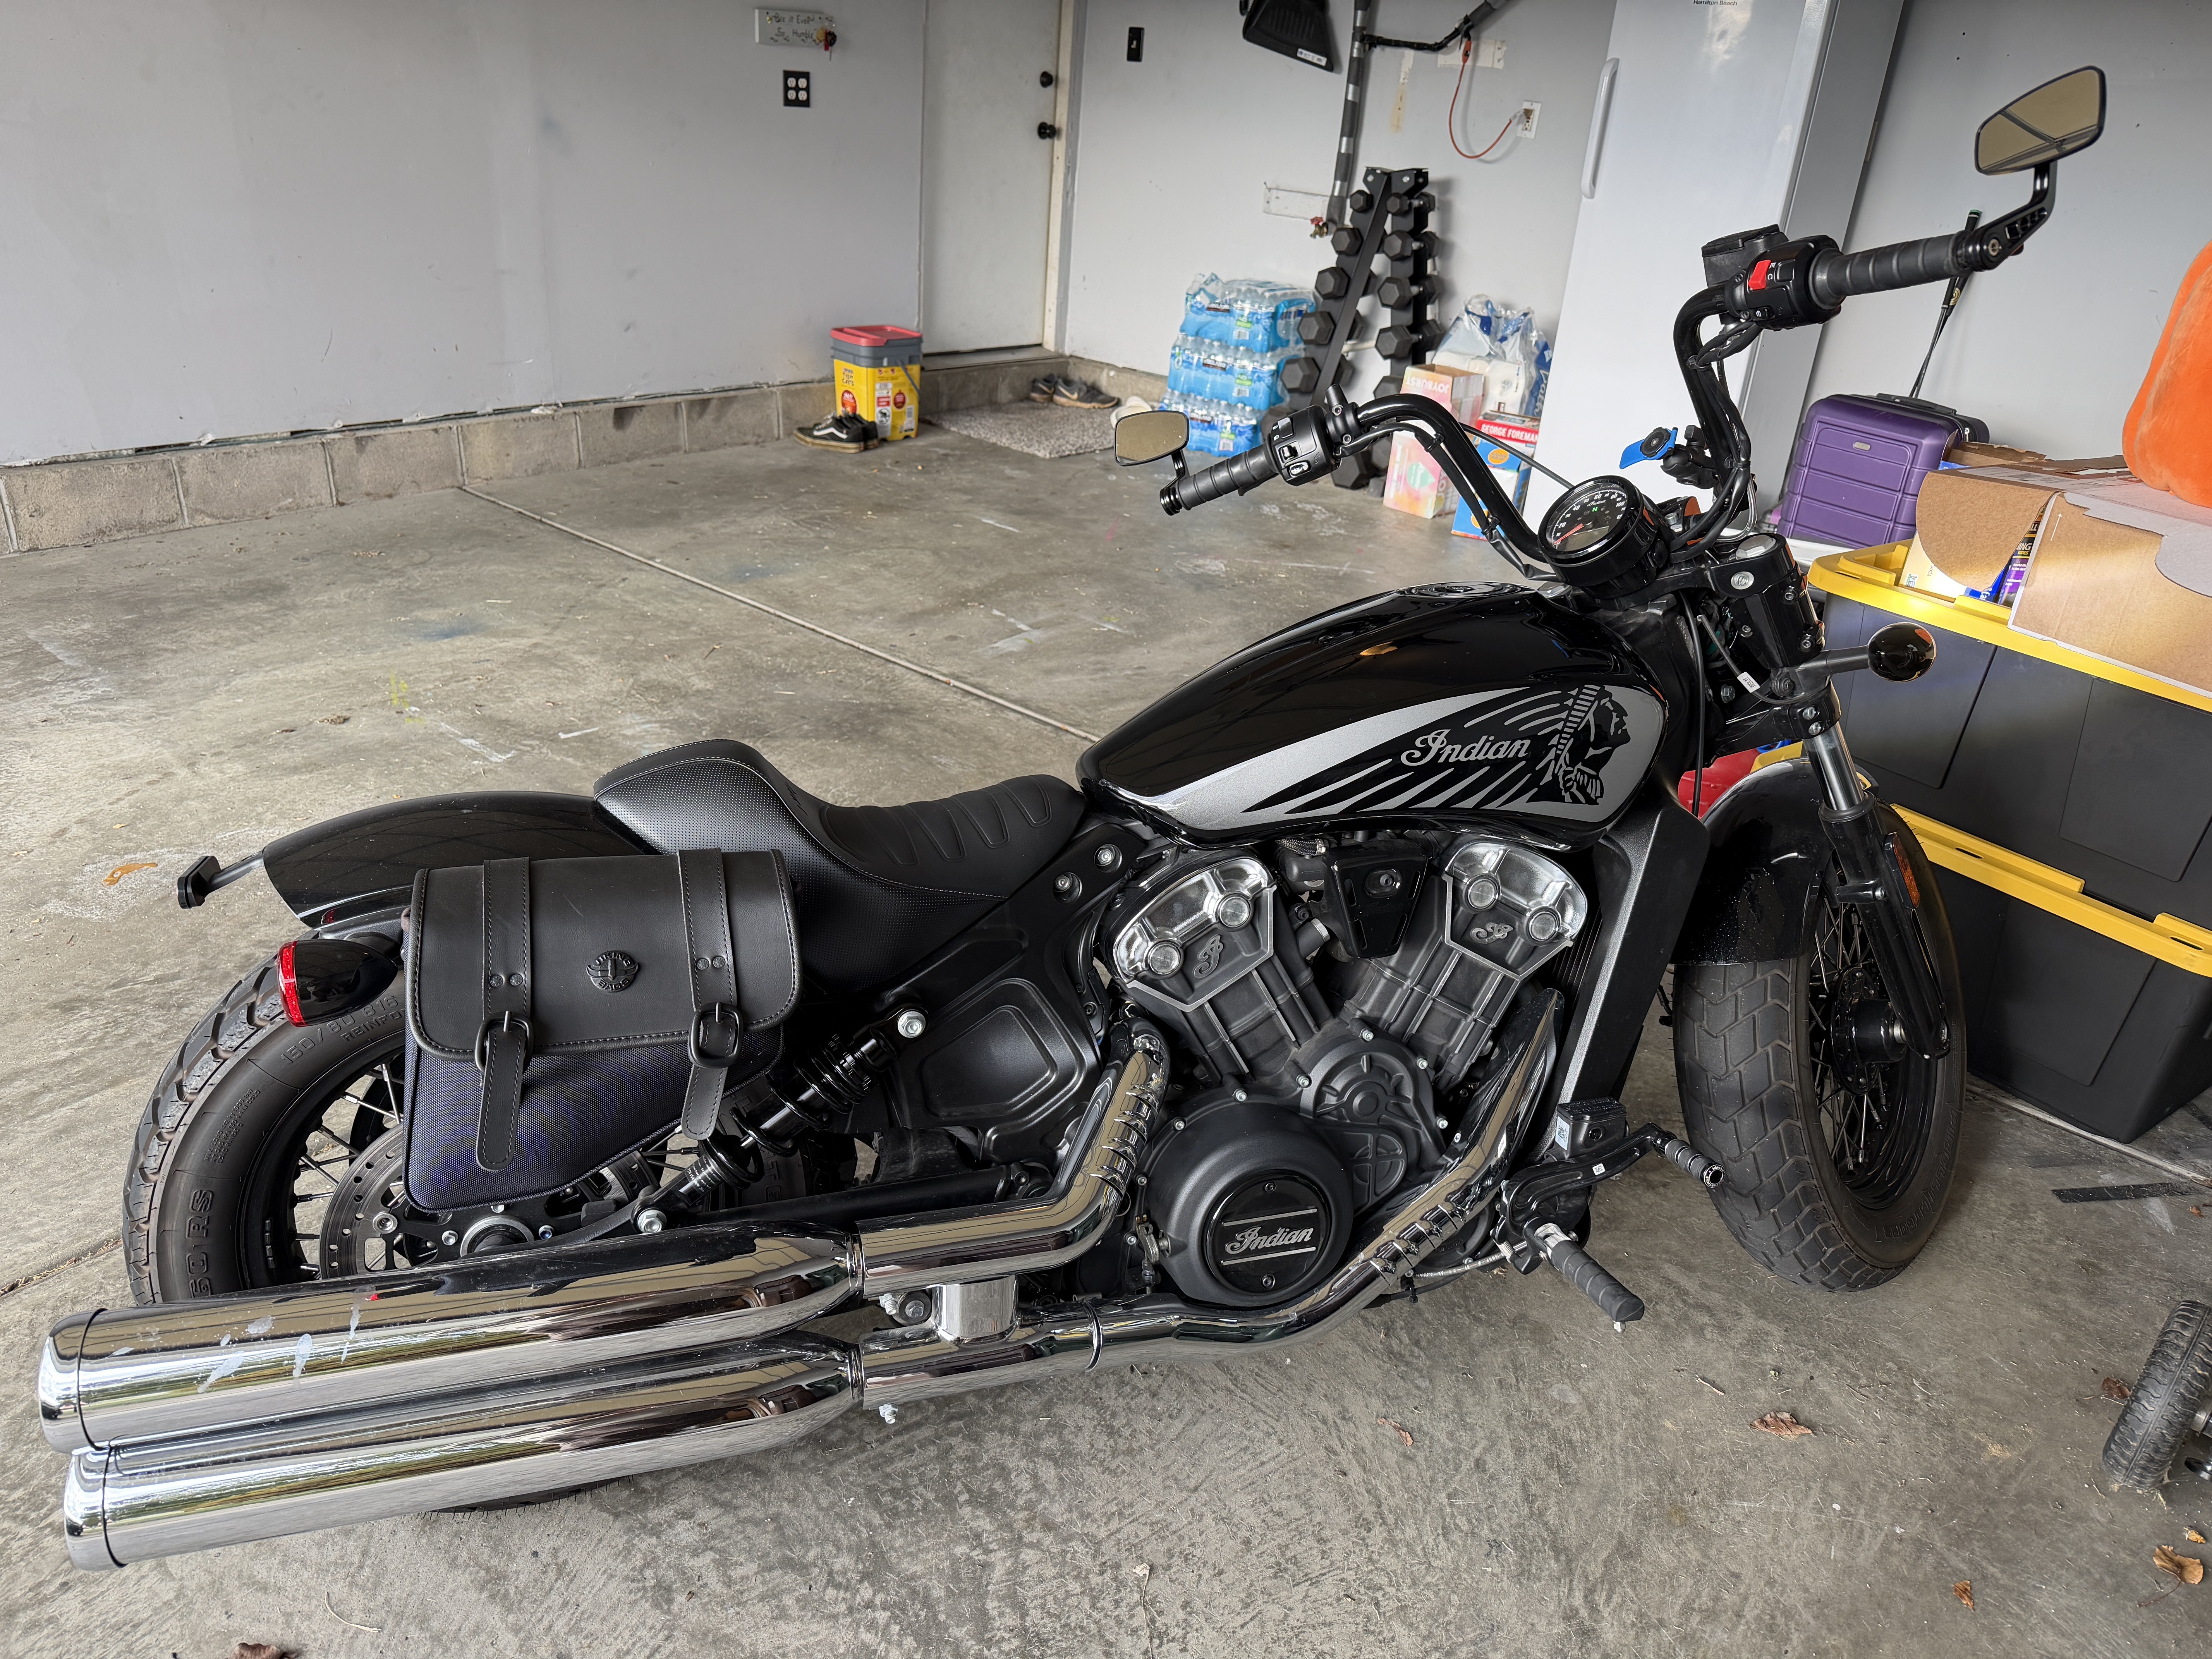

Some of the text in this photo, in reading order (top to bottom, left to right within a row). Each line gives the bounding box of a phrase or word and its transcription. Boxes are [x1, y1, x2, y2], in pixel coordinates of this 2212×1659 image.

[1406, 376, 1450, 394] JOYBURST
[1481, 423, 1539, 443] GEORGE FOREMAN
[1400, 728, 1530, 766] Indian
[593, 952, 631, 967] VIKING
[596, 978, 629, 992] BAGS
[362, 995, 398, 1018] B16
[1927, 1108, 1958, 1202] PIRELLI
[1224, 1225, 1314, 1255] Indian
